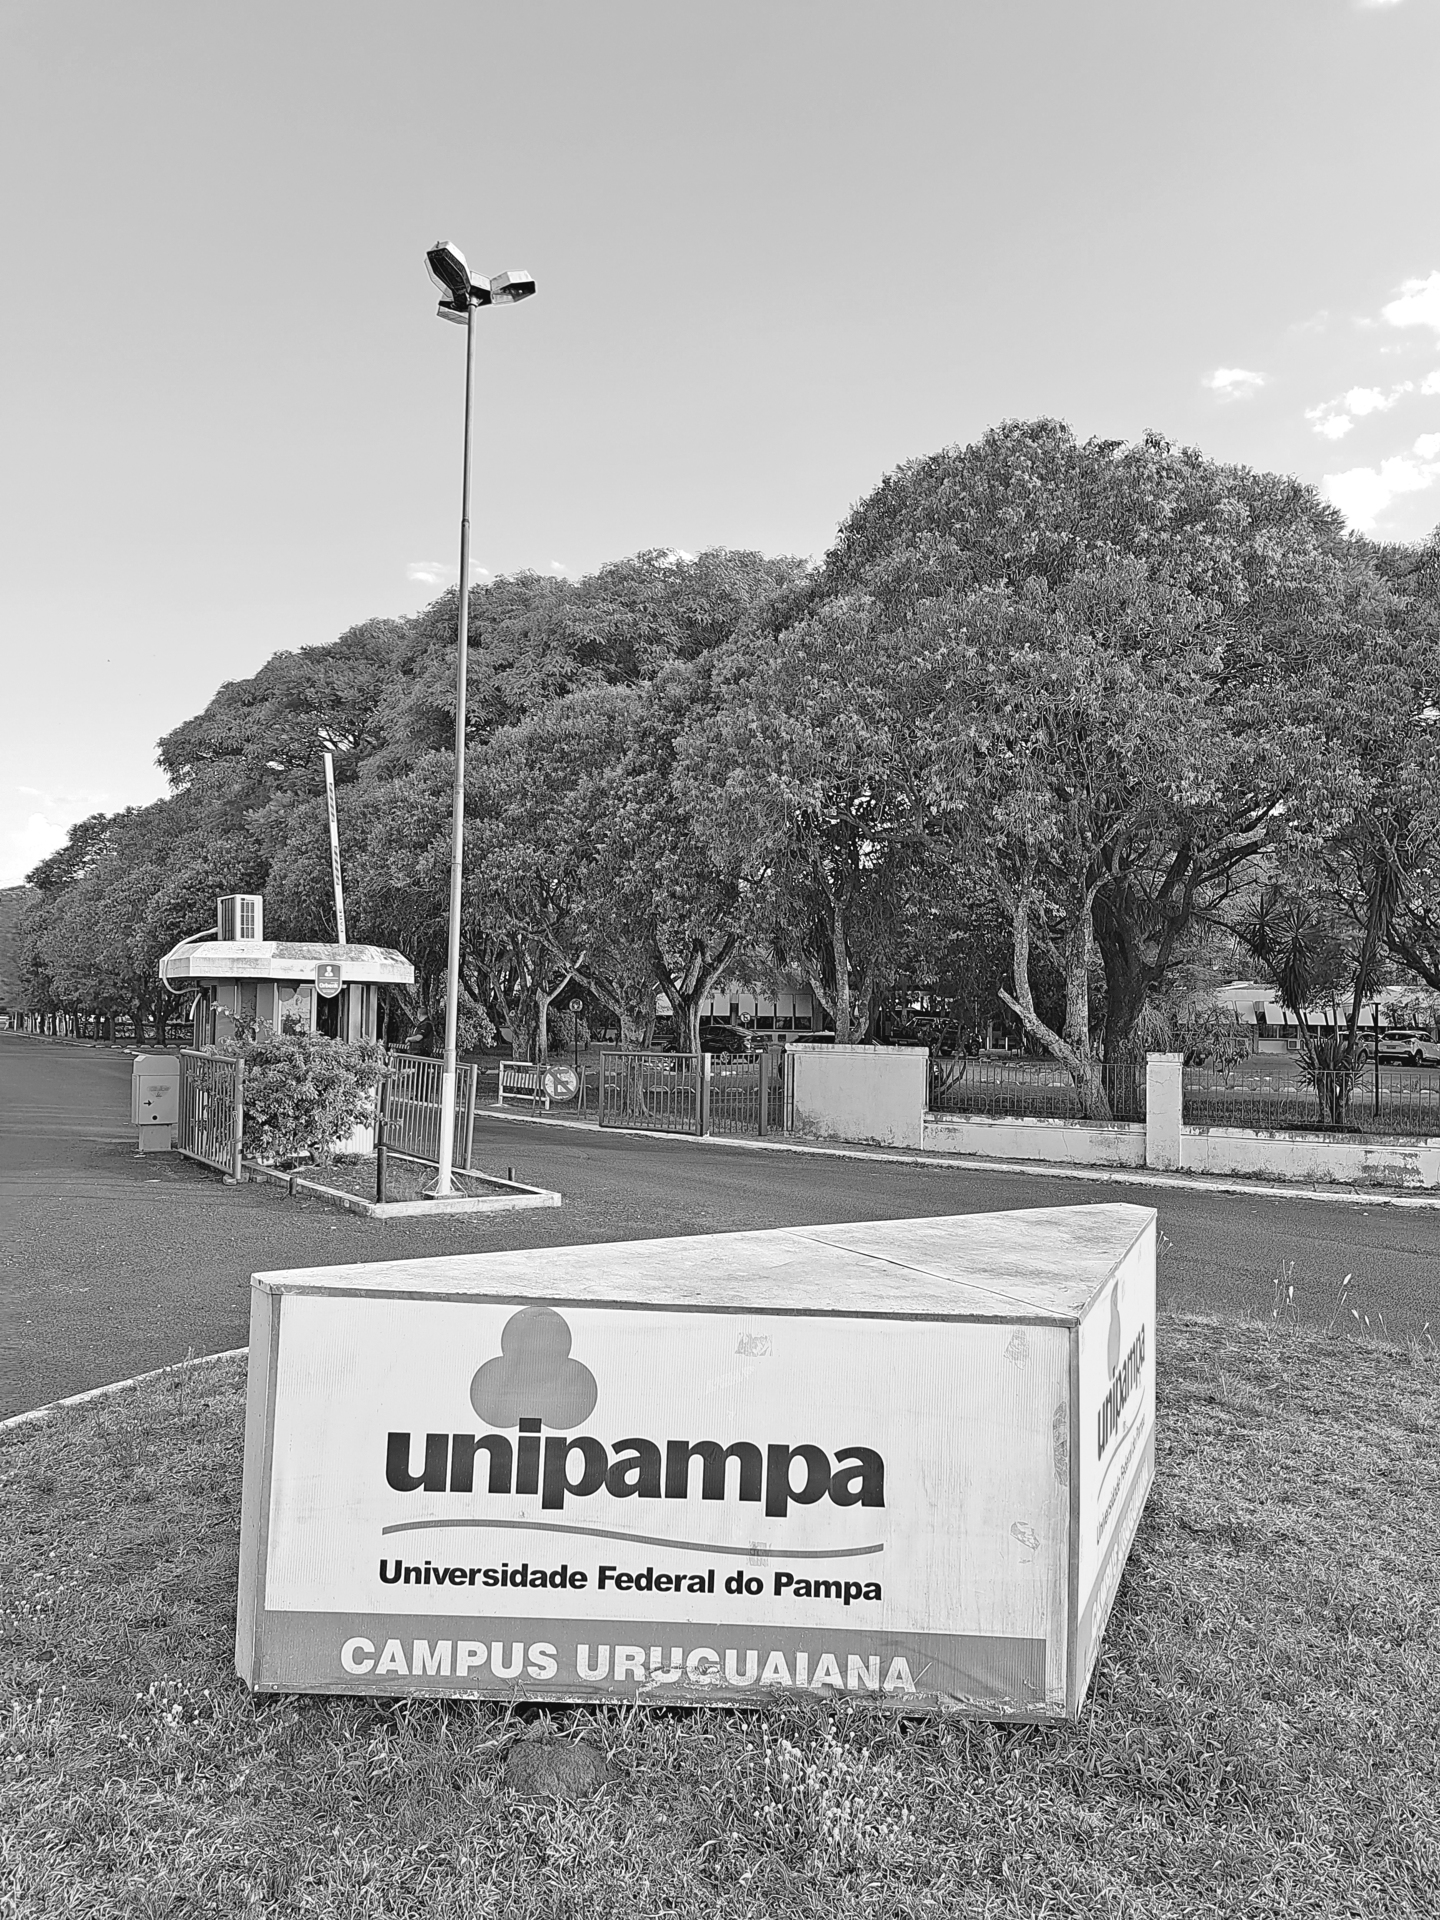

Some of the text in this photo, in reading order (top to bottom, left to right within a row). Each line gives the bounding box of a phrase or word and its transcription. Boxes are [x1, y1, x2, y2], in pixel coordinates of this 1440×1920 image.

[1098, 1322, 1145, 1462] unipampa
[385, 1417, 886, 1519] unipampa
[379, 1559, 882, 1606] Universidade Federal do Pampa
[340, 1636, 917, 1693] CAMPUS URUGUAIANA
